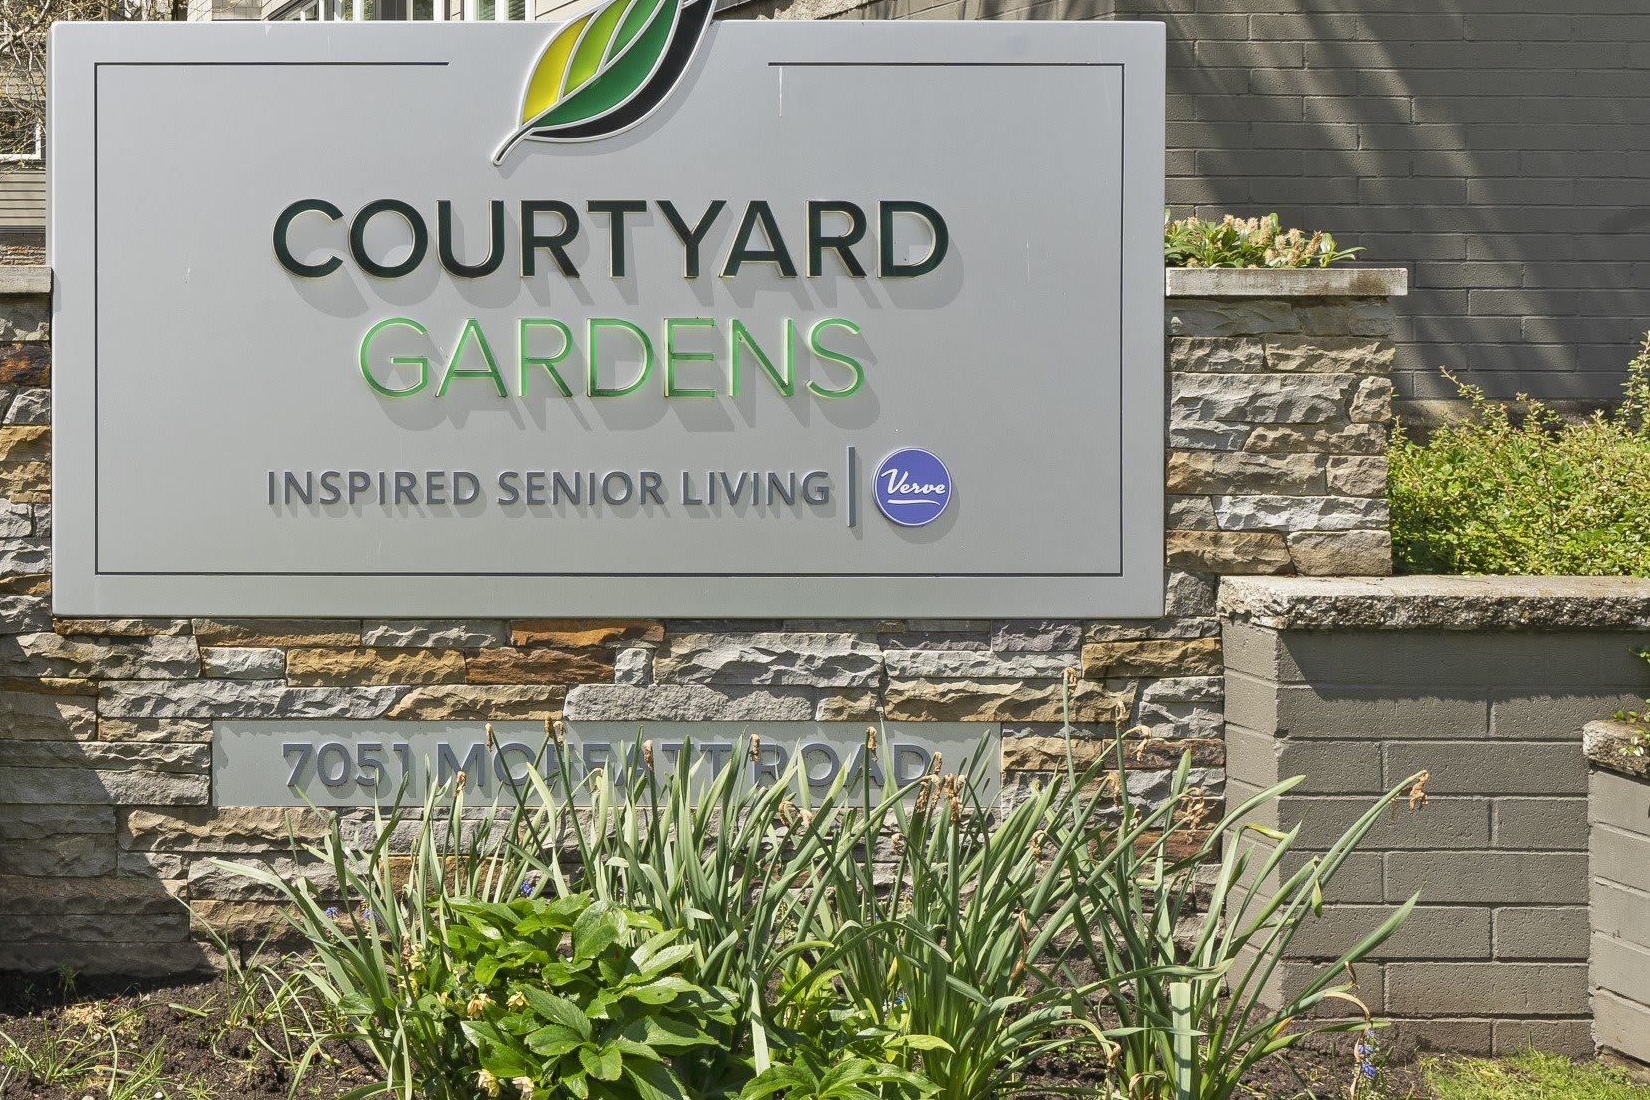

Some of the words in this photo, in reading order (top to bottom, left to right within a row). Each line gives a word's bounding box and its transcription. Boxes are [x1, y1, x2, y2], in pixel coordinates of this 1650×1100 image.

[271, 198, 950, 279] COURTYARD
[357, 316, 866, 399] GARDENS
[267, 470, 480, 506] INSPIRED
[497, 470, 665, 506] SENIOR
[682, 470, 831, 506] LIVING
[880, 468, 946, 495] Verve
[282, 742, 410, 788] 7051
[753, 742, 932, 788] ROAD
